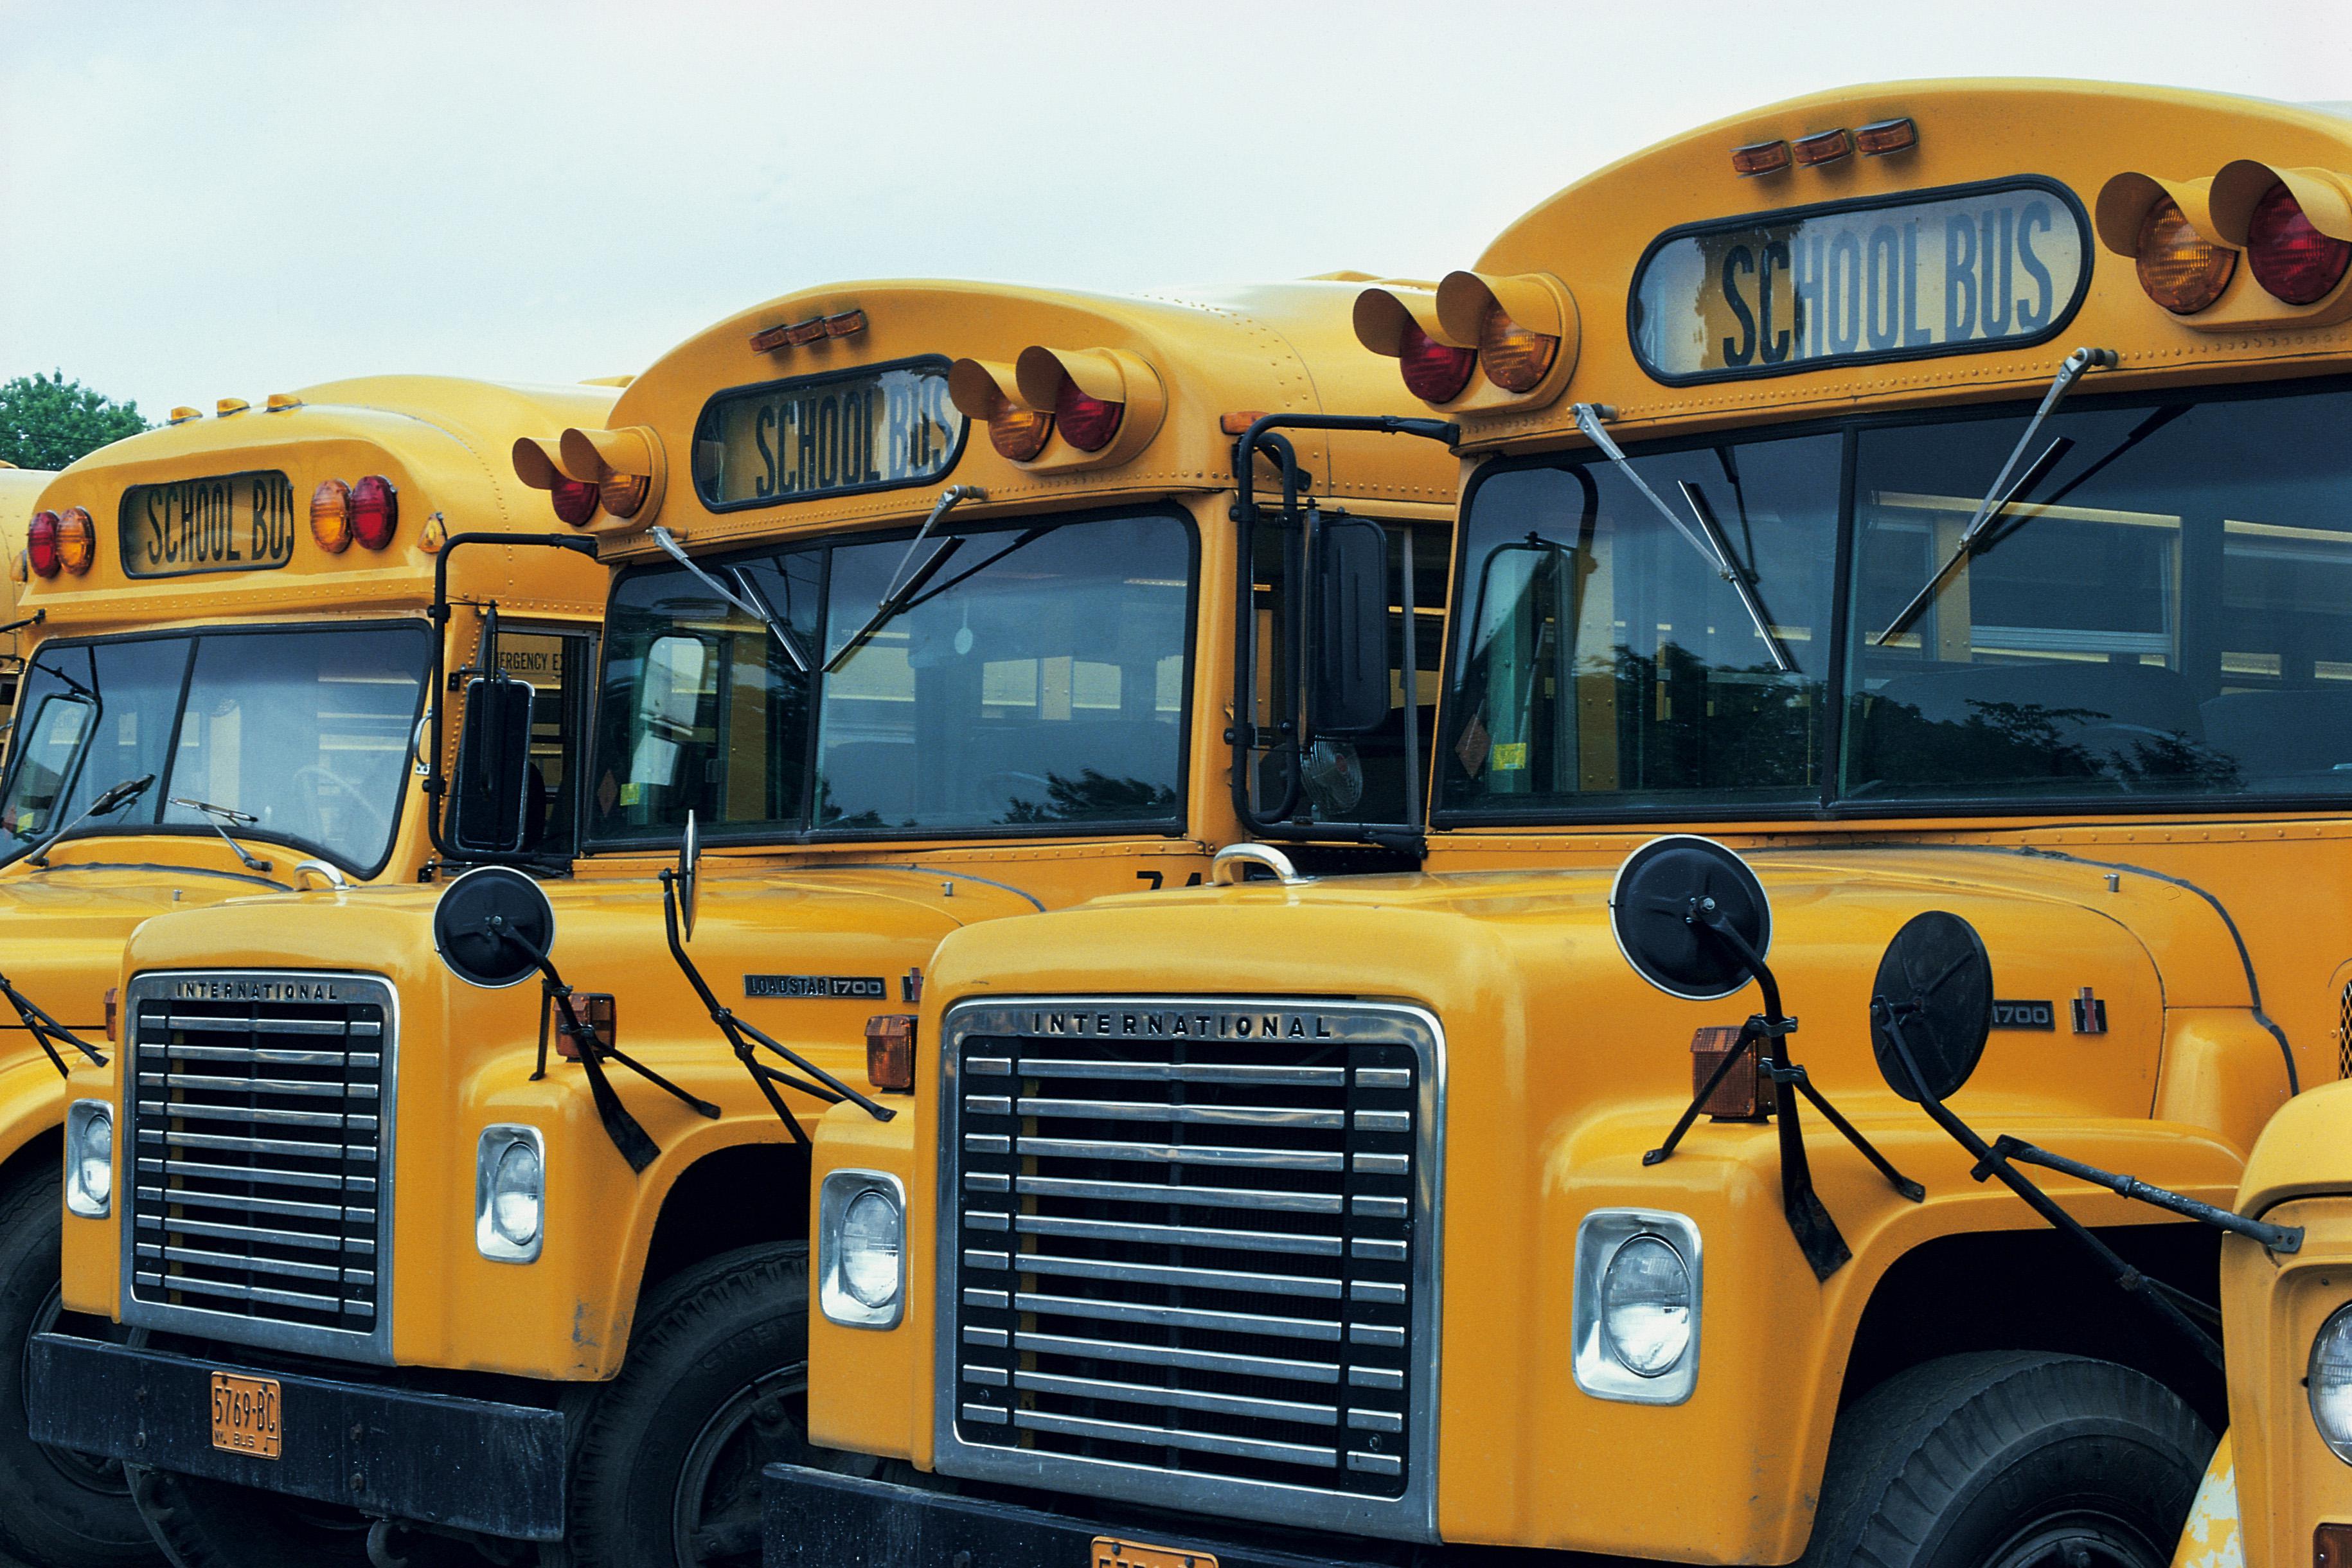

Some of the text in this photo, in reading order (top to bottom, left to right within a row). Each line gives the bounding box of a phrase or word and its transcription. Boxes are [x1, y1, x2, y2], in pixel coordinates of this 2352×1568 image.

[1722, 200, 2053, 367] SCHOOL BUS
[756, 375, 955, 497] SCHOOL BUS
[147, 481, 241, 564] SCHOOL
[176, 981, 338, 1000] INTERNATIONAL
[750, 977, 882, 995] LOADSTAR 1700
[1033, 1012, 1332, 1038] INTERNATIONAL
[1993, 1006, 2049, 1023] 1700
[215, 1385, 275, 1432] 5769-BC
[233, 1430, 255, 1447] BUS
